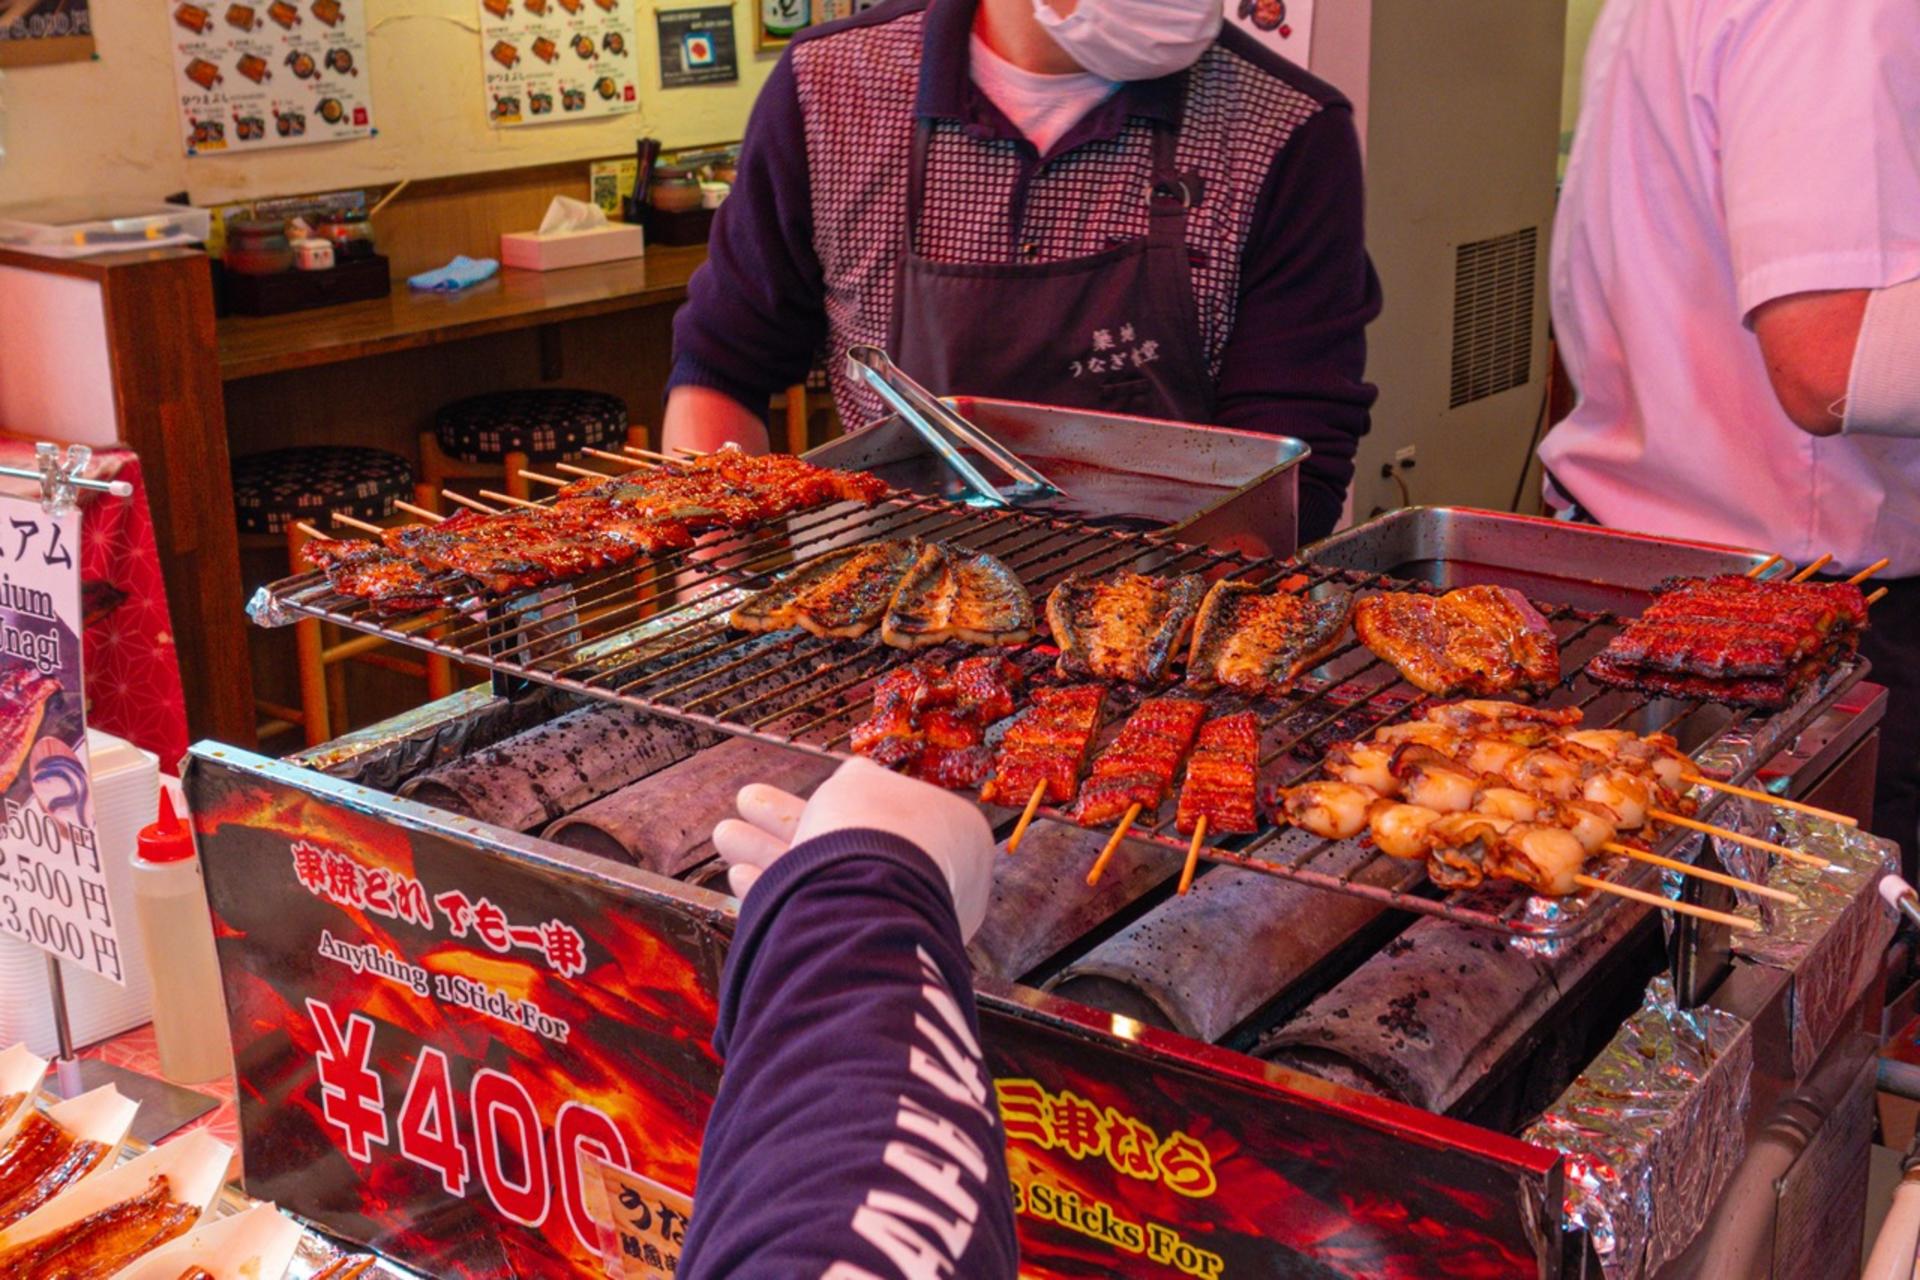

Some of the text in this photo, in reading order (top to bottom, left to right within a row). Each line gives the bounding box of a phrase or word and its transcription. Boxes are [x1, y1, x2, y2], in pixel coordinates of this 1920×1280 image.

[0, 516, 72, 571] アム
[0, 573, 55, 621] ium
[318, 930, 428, 997] Anything
[518, 1000, 570, 1044] For
[1029, 1182, 1145, 1252] Sticks
[1147, 1222, 1224, 1280] For
